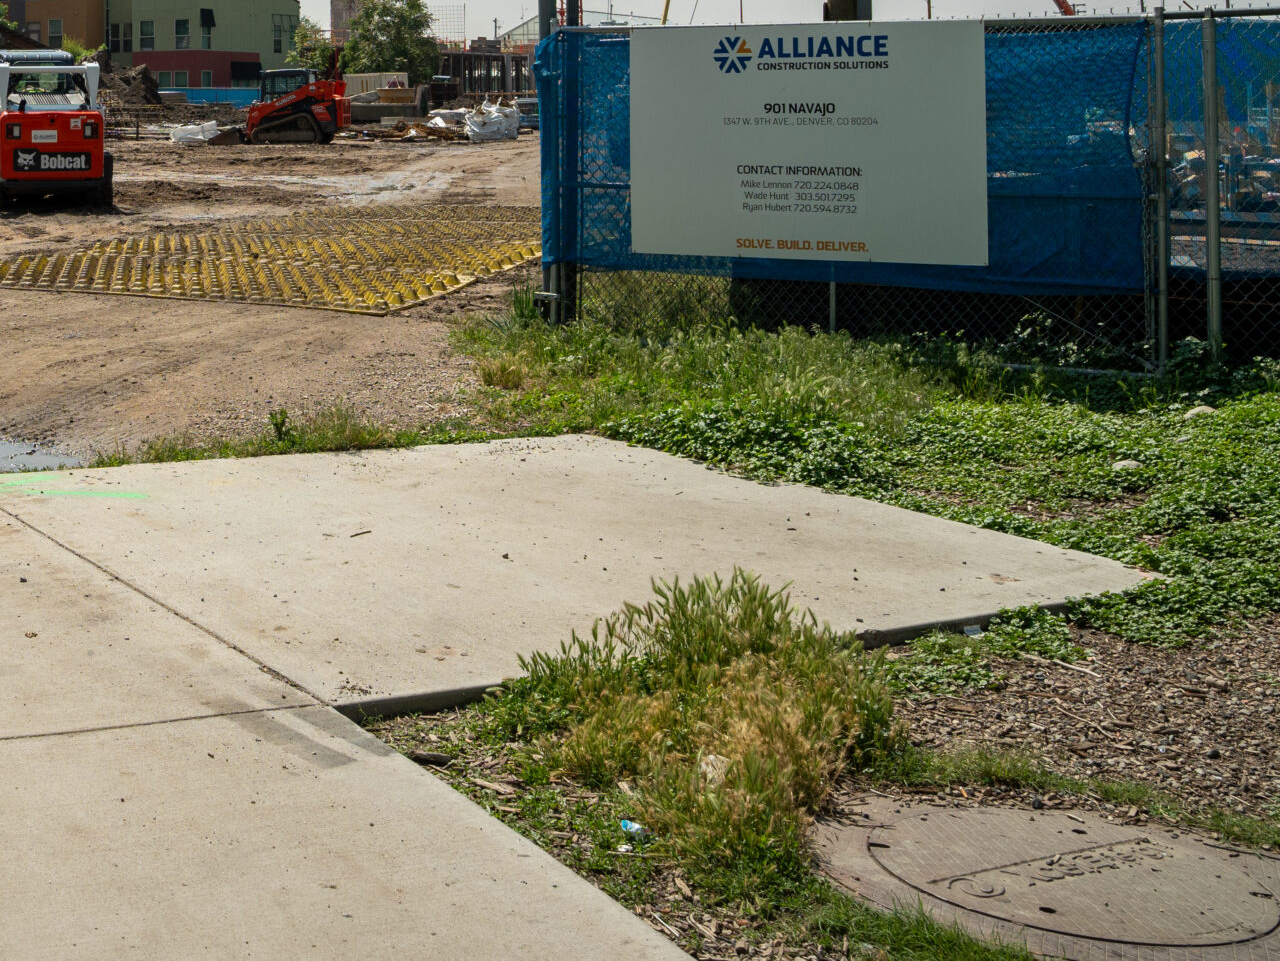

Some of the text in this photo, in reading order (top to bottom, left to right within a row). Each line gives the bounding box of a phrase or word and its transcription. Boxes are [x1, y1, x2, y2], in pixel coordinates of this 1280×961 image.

[758, 35, 889, 58] ALLIANCE
[757, 60, 889, 70] CONSTRUCTION SOLUTIONS
[764, 103, 836, 116] 901 NAVAJO
[723, 117, 741, 126] 1347
[742, 117, 752, 126] W.
[754, 117, 771, 126] 9TH
[797, 117, 835, 127] DENVER,
[837, 117, 849, 126] CO
[851, 117, 878, 126] 80204
[40, 154, 86, 169] Bobcat
[737, 165, 863, 177] CONTACT INFORMATION:
[740, 180, 859, 191] Mike Lennon 720.224.0848
[744, 191, 856, 202] Wade Hunt 303.501.7295
[742, 203, 857, 214] Ryan Hubert 720.594.8732
[736, 238, 869, 252] SOLVE. BUILD. DELIVER.
